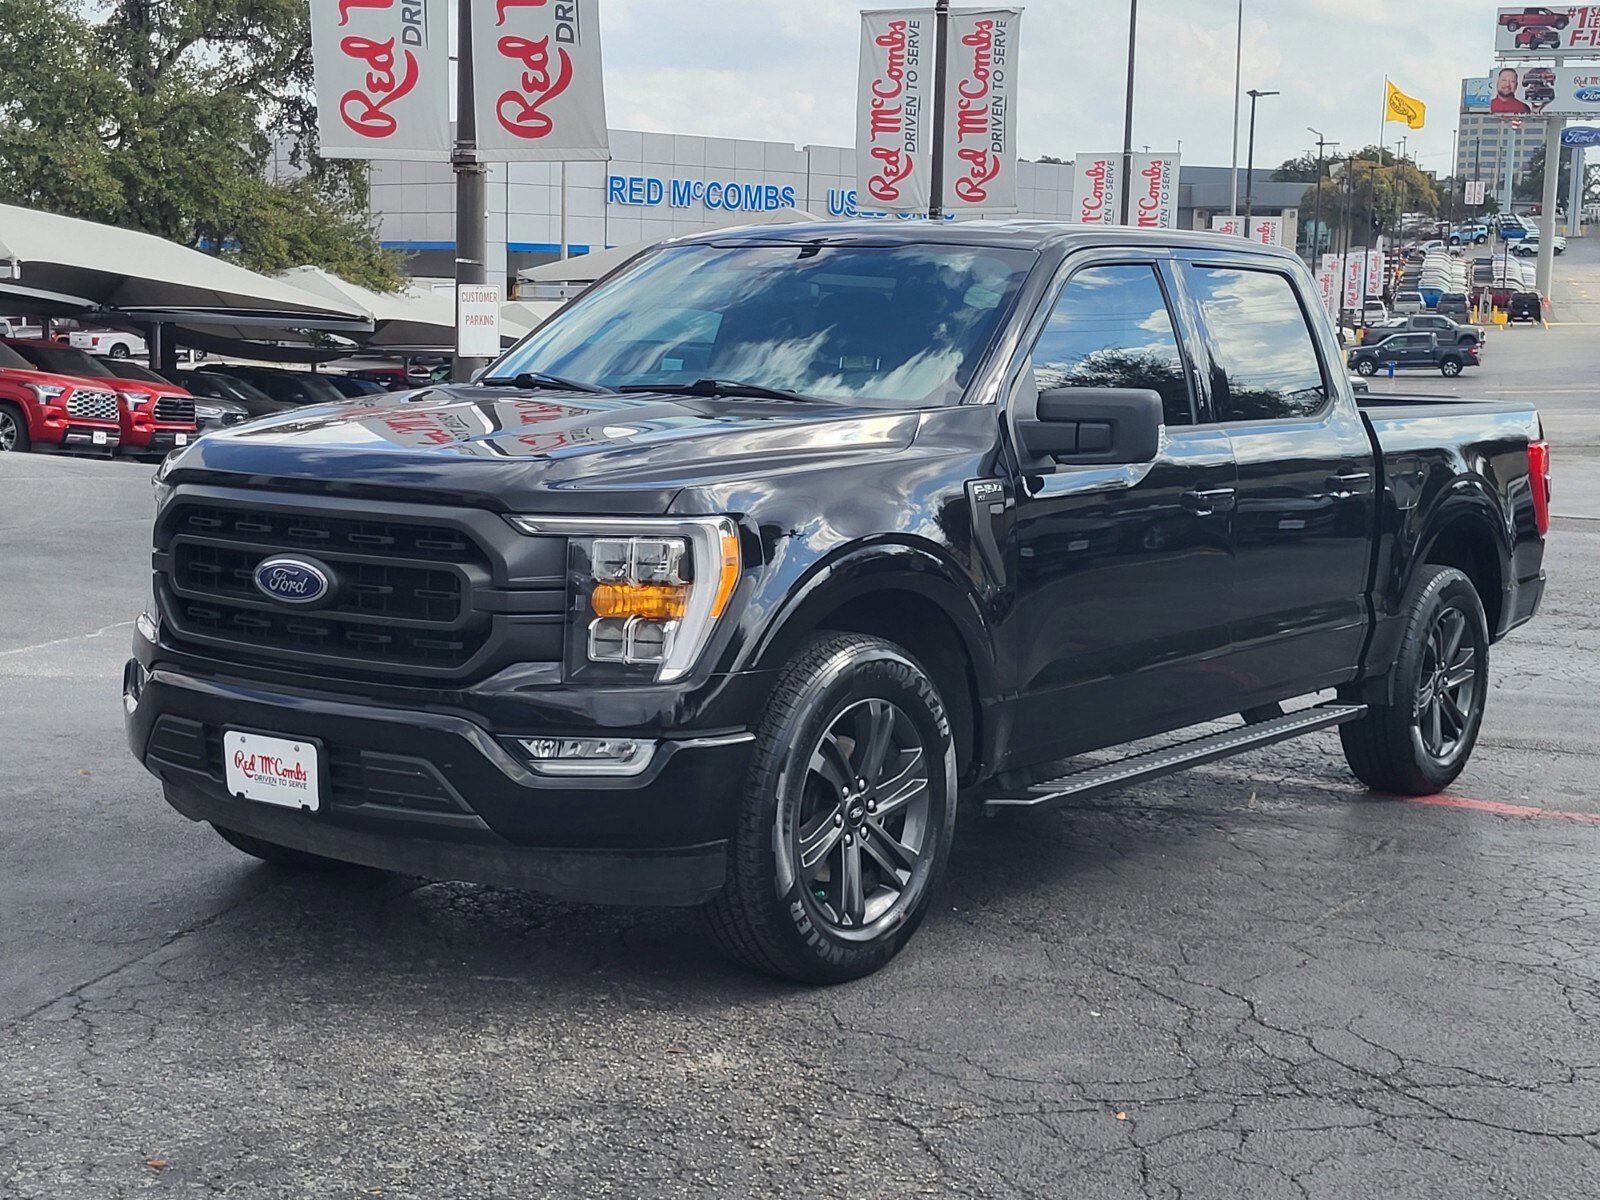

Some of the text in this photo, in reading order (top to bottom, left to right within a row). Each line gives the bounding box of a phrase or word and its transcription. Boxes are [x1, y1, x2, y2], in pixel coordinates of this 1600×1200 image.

[339, 36, 418, 138] Red
[496, 35, 573, 138] Red
[904, 20, 920, 153] DRIVEN TO SERVE
[991, 20, 1007, 153] DRIVEN TO SERVE
[868, 20, 913, 201] Red McCombs
[955, 20, 1000, 202] Red McCombs
[1105, 160, 1115, 190] SERVE
[1162, 160, 1172, 190] SERVE
[609, 176, 663, 205] RED
[1105, 193, 1113, 205] TO
[1161, 193, 1169, 205] TO
[461, 291, 498, 303] CUSTOMER
[465, 314, 494, 326] PARKING
[269, 568, 309, 594] Ford
[234, 750, 307, 782] Red McCombs
[254, 774, 307, 791] DRIVEN TO SERVE
